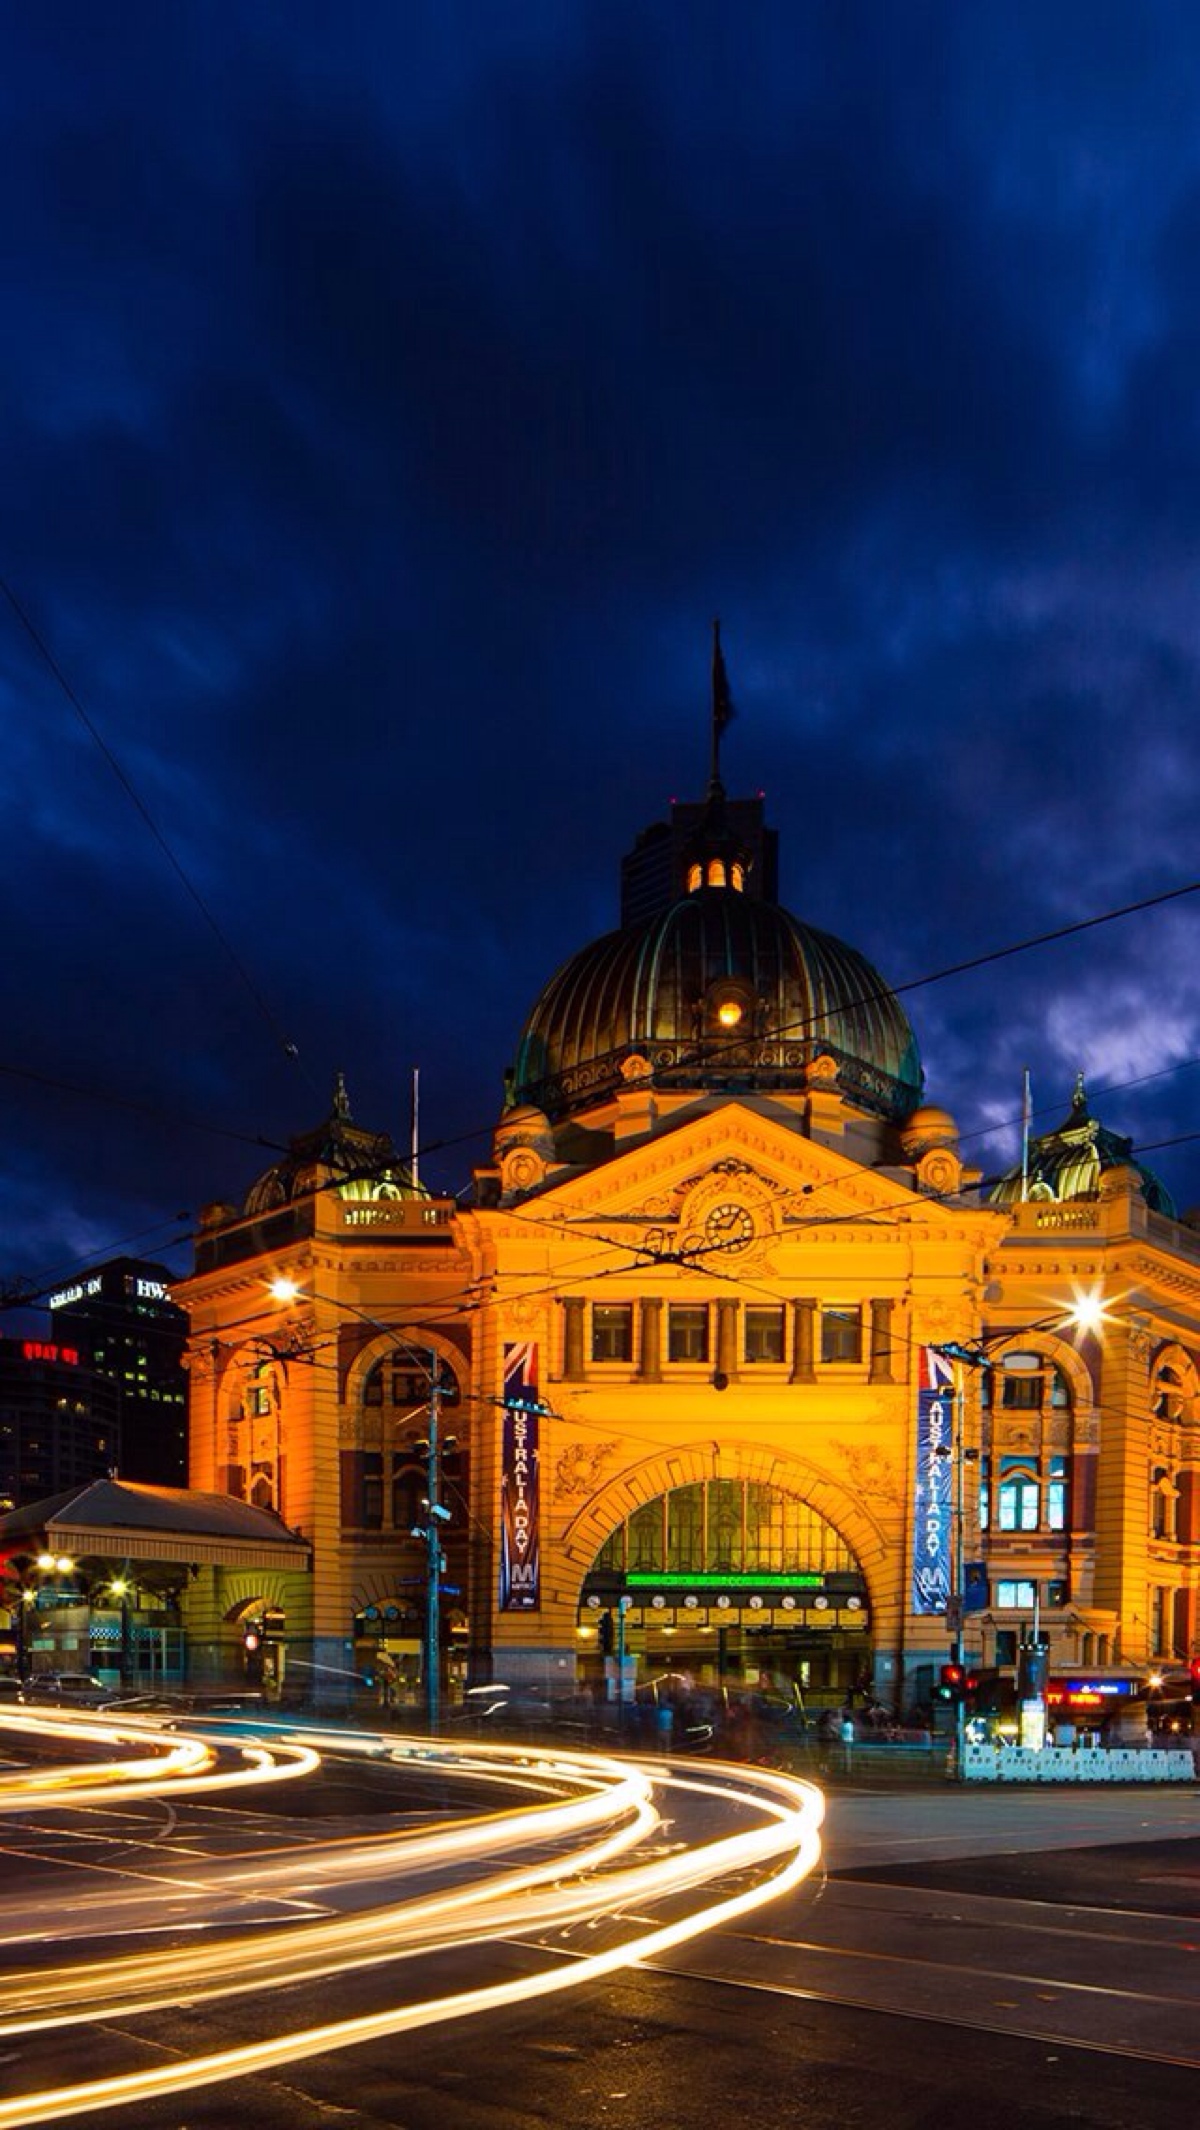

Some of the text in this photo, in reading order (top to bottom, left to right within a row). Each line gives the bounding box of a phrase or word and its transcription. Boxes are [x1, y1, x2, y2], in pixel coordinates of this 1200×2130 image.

[513, 1411, 529, 1554] USTRALIA DAY
[926, 1519, 940, 1558] DAY
